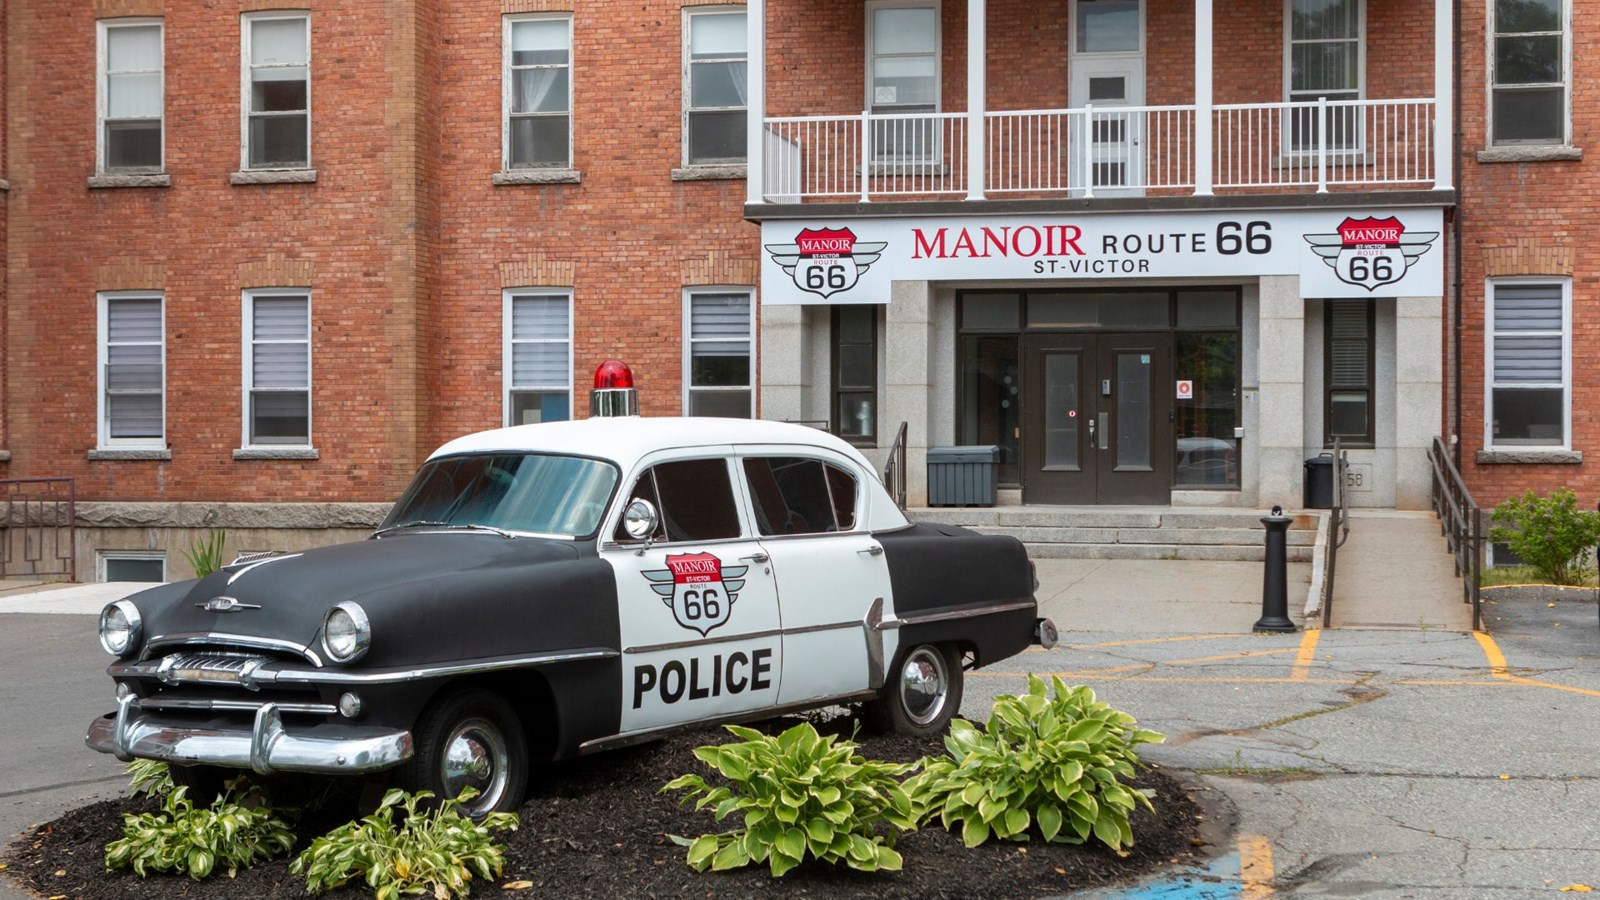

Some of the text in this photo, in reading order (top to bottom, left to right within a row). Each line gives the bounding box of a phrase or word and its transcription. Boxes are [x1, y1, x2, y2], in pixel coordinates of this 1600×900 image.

[911, 221, 1272, 259] MANOIR ROUTE 66
[1343, 229, 1398, 240] MANOIR
[801, 239, 851, 251] MANOIR
[1034, 259, 1150, 274] ST-VICTOR
[1349, 256, 1392, 281] 66
[806, 265, 846, 289] 66
[673, 560, 717, 573] MANOIR
[685, 575, 711, 583] ST-VICTOR
[684, 589, 720, 620] 66
[633, 648, 772, 709] POLICE
